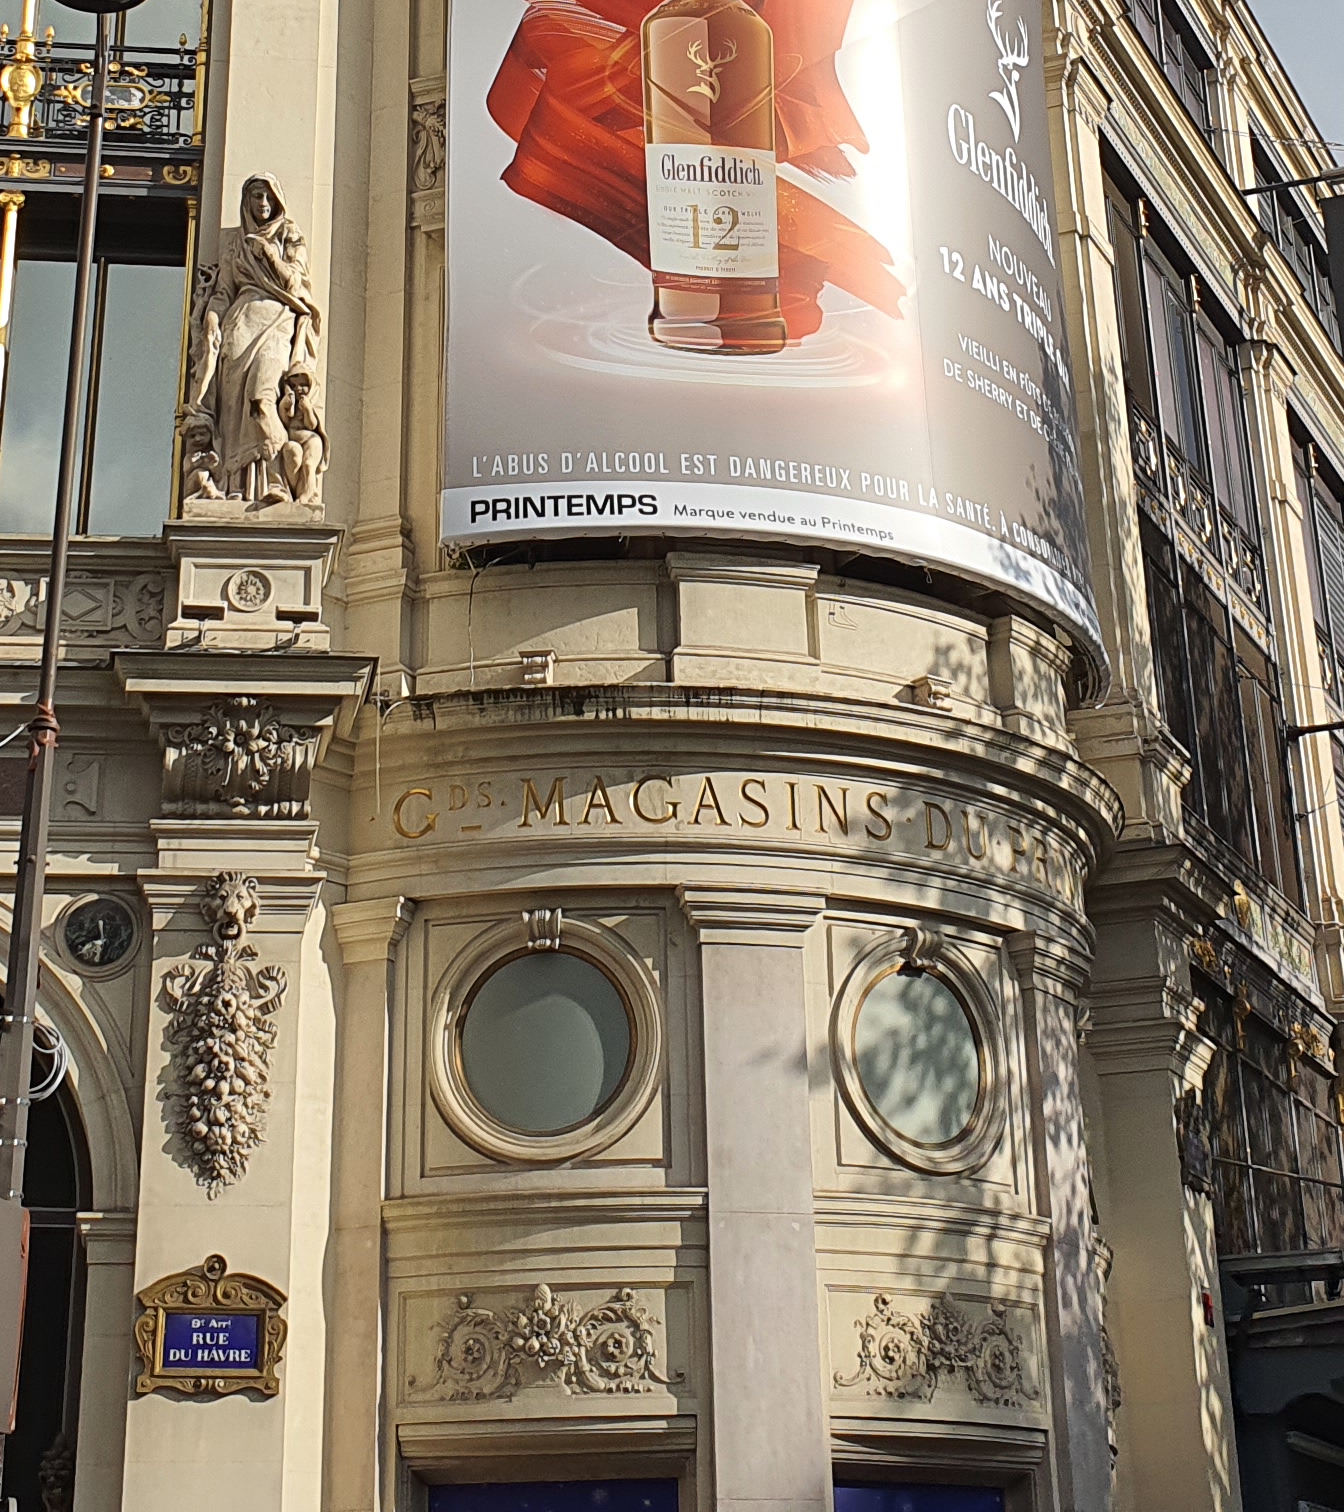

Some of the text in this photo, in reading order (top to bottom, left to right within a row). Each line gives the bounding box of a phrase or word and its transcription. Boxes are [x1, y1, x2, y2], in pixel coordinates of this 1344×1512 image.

[686, 203, 741, 252] 12
[939, 245, 967, 283] 12
[972, 264, 1011, 312] ANS
[1012, 291, 1056, 364] TRIPLE
[988, 233, 1052, 322] NOUVEAU
[943, 357, 963, 383] DE
[967, 369, 1013, 412] SHERRY
[1015, 399, 1028, 422] ET
[1030, 409, 1043, 435] DE
[957, 332, 1000, 372] VIEILLI
[1002, 360, 1018, 386] EN
[1019, 371, 1042, 406] FÛTS
[470, 493, 895, 542] PRINTEMPS Marque vendue au Printemps
[471, 451, 550, 478] L'ABUS
[560, 451, 670, 476] D'ALCOOL
[680, 453, 718, 476] EST
[729, 456, 852, 491] DANGEREUX
[860, 472, 910, 502] POUR
[917, 483, 939, 510] LA
[945, 492, 997, 532] SANTÉ.
[517, 773, 895, 843] MAGASINS
[923, 799, 989, 862] DU
[168, 1349, 192, 1362] DU
[192, 1332, 230, 1345] RUE
